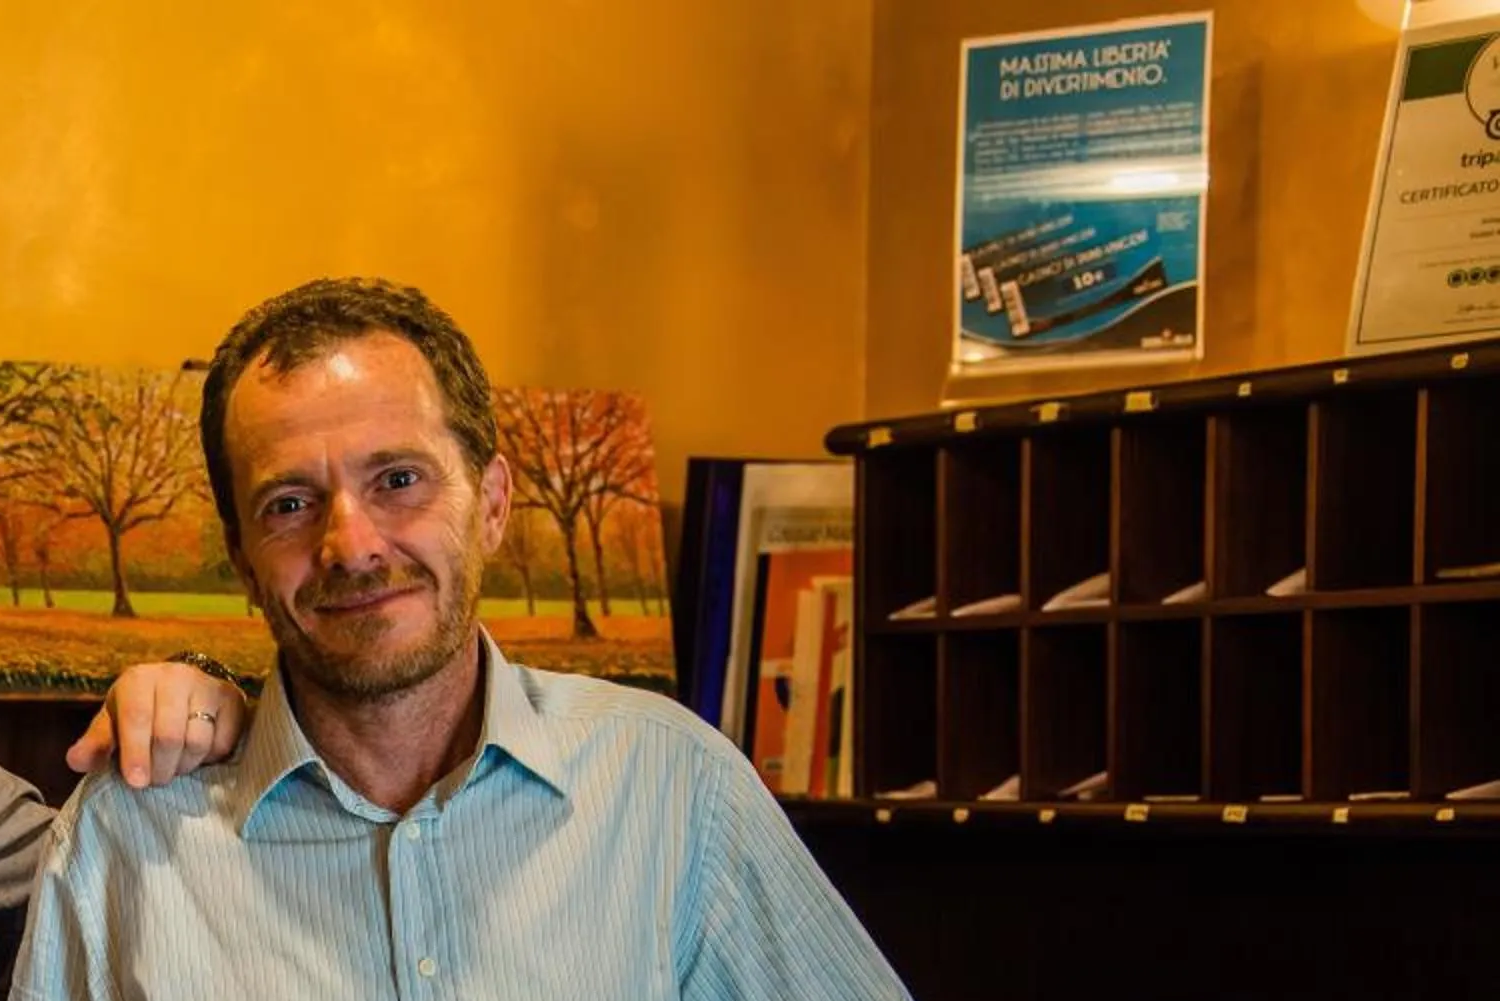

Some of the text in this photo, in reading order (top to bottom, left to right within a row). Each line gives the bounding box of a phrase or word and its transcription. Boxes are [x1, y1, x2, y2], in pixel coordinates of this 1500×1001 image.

[1000, 49, 1086, 77] MASSIMA
[1000, 79, 1019, 100] DI
[1400, 178, 1499, 205] CERTIFICATO
